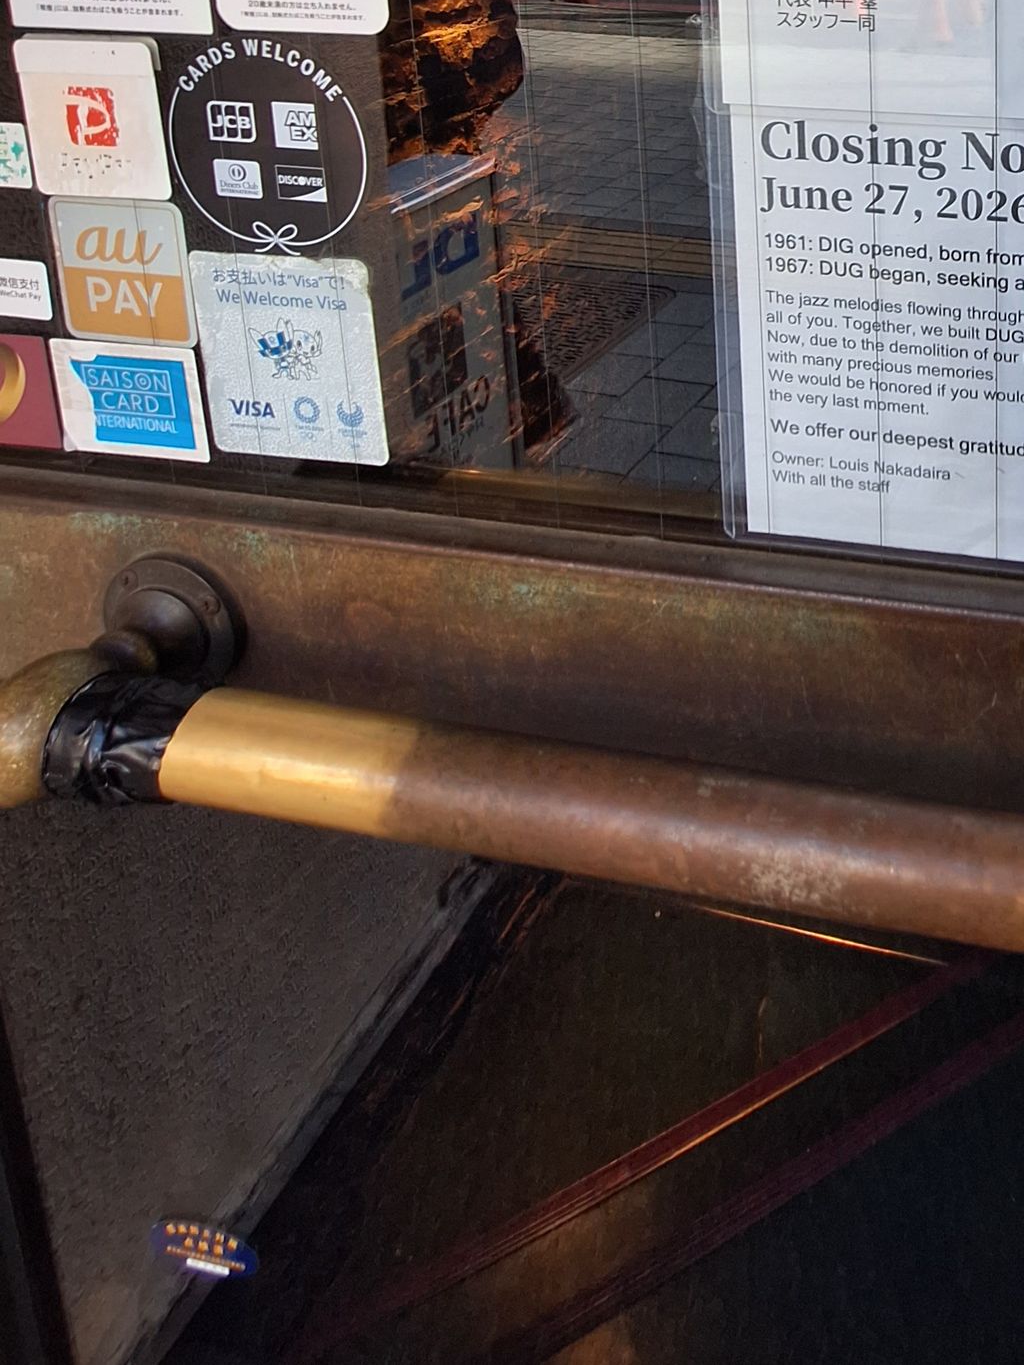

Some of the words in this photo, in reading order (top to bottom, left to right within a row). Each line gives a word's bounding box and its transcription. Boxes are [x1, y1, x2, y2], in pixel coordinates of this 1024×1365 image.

[777, 12, 876, 32] スタッフ一同
[178, 40, 237, 93] CARDS
[241, 38, 344, 105] WELCOME
[211, 115, 252, 129] JCB
[760, 120, 947, 181] Closing
[278, 175, 322, 187] DISCOVER
[760, 177, 852, 213] June
[865, 183, 922, 223] 27,
[76, 219, 164, 265] au
[765, 234, 813, 251] 1961:
[819, 237, 854, 254] DIG
[859, 242, 934, 261] opened,
[939, 245, 981, 263] born
[766, 258, 814, 275] 1967:
[820, 261, 863, 278] DUG
[869, 263, 931, 286] began,
[937, 271, 1009, 292] seeking
[87, 276, 163, 318] PAY
[216, 288, 240, 303] We
[244, 290, 313, 309] Welcome
[317, 296, 347, 311] Visa
[766, 290, 794, 305] The
[798, 293, 828, 308] jazz
[834, 298, 902, 314] melodies
[908, 301, 962, 321] flowing
[766, 312, 783, 324] all
[806, 317, 838, 330] you.
[843, 316, 916, 336] Together,
[921, 325, 944, 337] we
[948, 325, 980, 340] built
[767, 330, 804, 346] Now,
[810, 334, 838, 347] due
[889, 341, 969, 360] demolition
[993, 351, 1019, 364] our
[87, 368, 168, 392] SAISON
[768, 351, 797, 364] with
[802, 355, 842, 370] many
[848, 359, 912, 375] precious
[917, 364, 997, 381] memories.
[769, 369, 794, 383] We
[798, 372, 841, 387] would
[869, 378, 932, 396] honored
[951, 386, 979, 401] you
[101, 392, 160, 413] CARD
[228, 398, 276, 418] VISA
[797, 393, 828, 409] very
[833, 394, 859, 409] last
[864, 398, 929, 415] moment.
[95, 414, 178, 434] NTERNATIONAL
[771, 419, 800, 435] We
[805, 422, 845, 439] offer
[849, 427, 878, 442] our
[883, 429, 955, 450] deepest
[772, 450, 824, 468] Owner:
[830, 456, 869, 472] Louis
[874, 460, 950, 480] Nakadaira
[772, 469, 805, 485] With
[810, 473, 826, 487] all
[859, 478, 891, 493] staff
